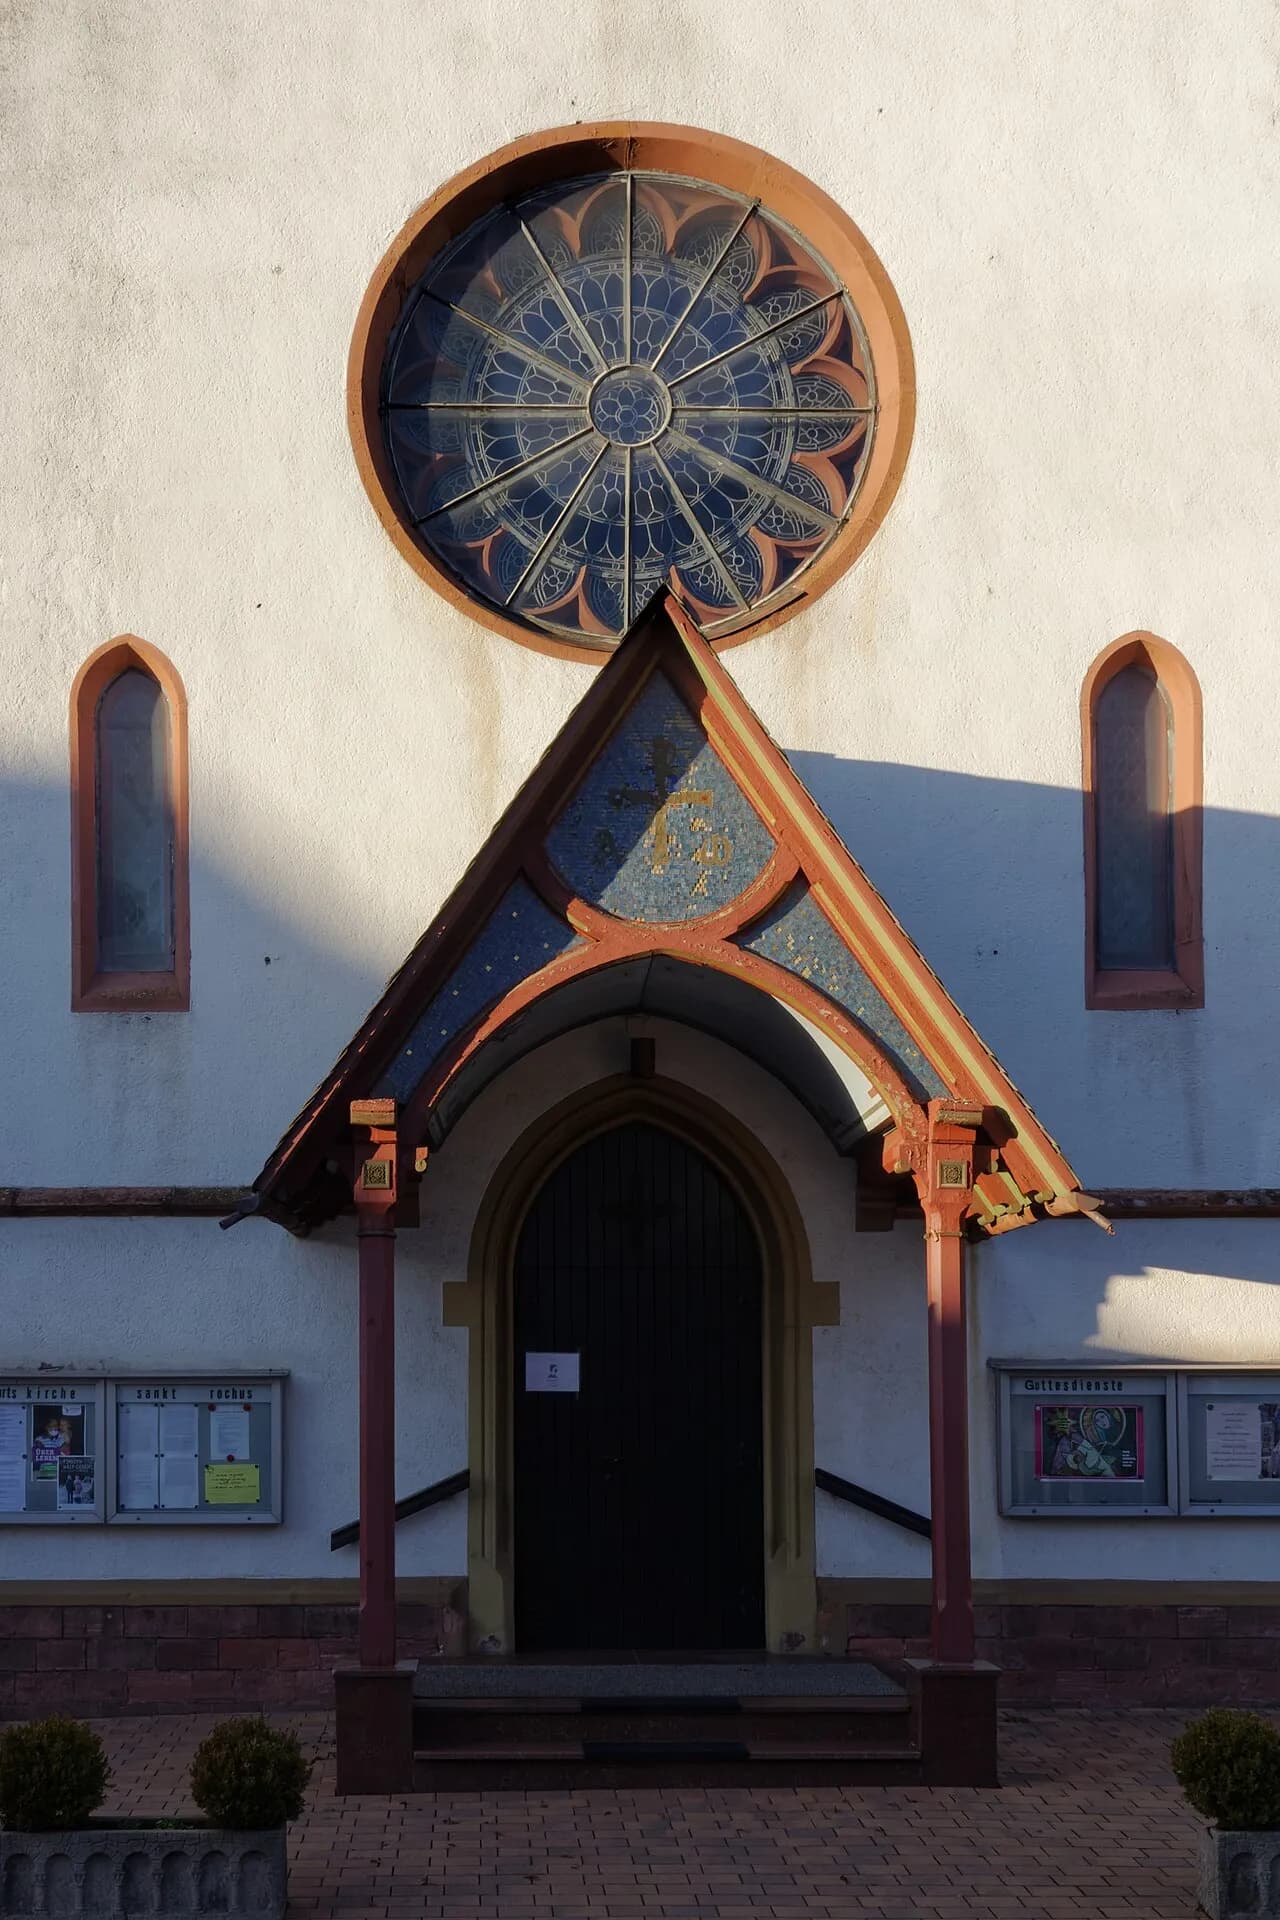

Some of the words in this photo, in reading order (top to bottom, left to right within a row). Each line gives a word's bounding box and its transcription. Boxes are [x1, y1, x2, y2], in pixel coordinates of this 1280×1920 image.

[1024, 1379, 1123, 1392] Gottesdienste
[26, 1386, 76, 1399] kirche
[136, 1387, 177, 1400] sankt
[208, 1387, 253, 1400] rochus
